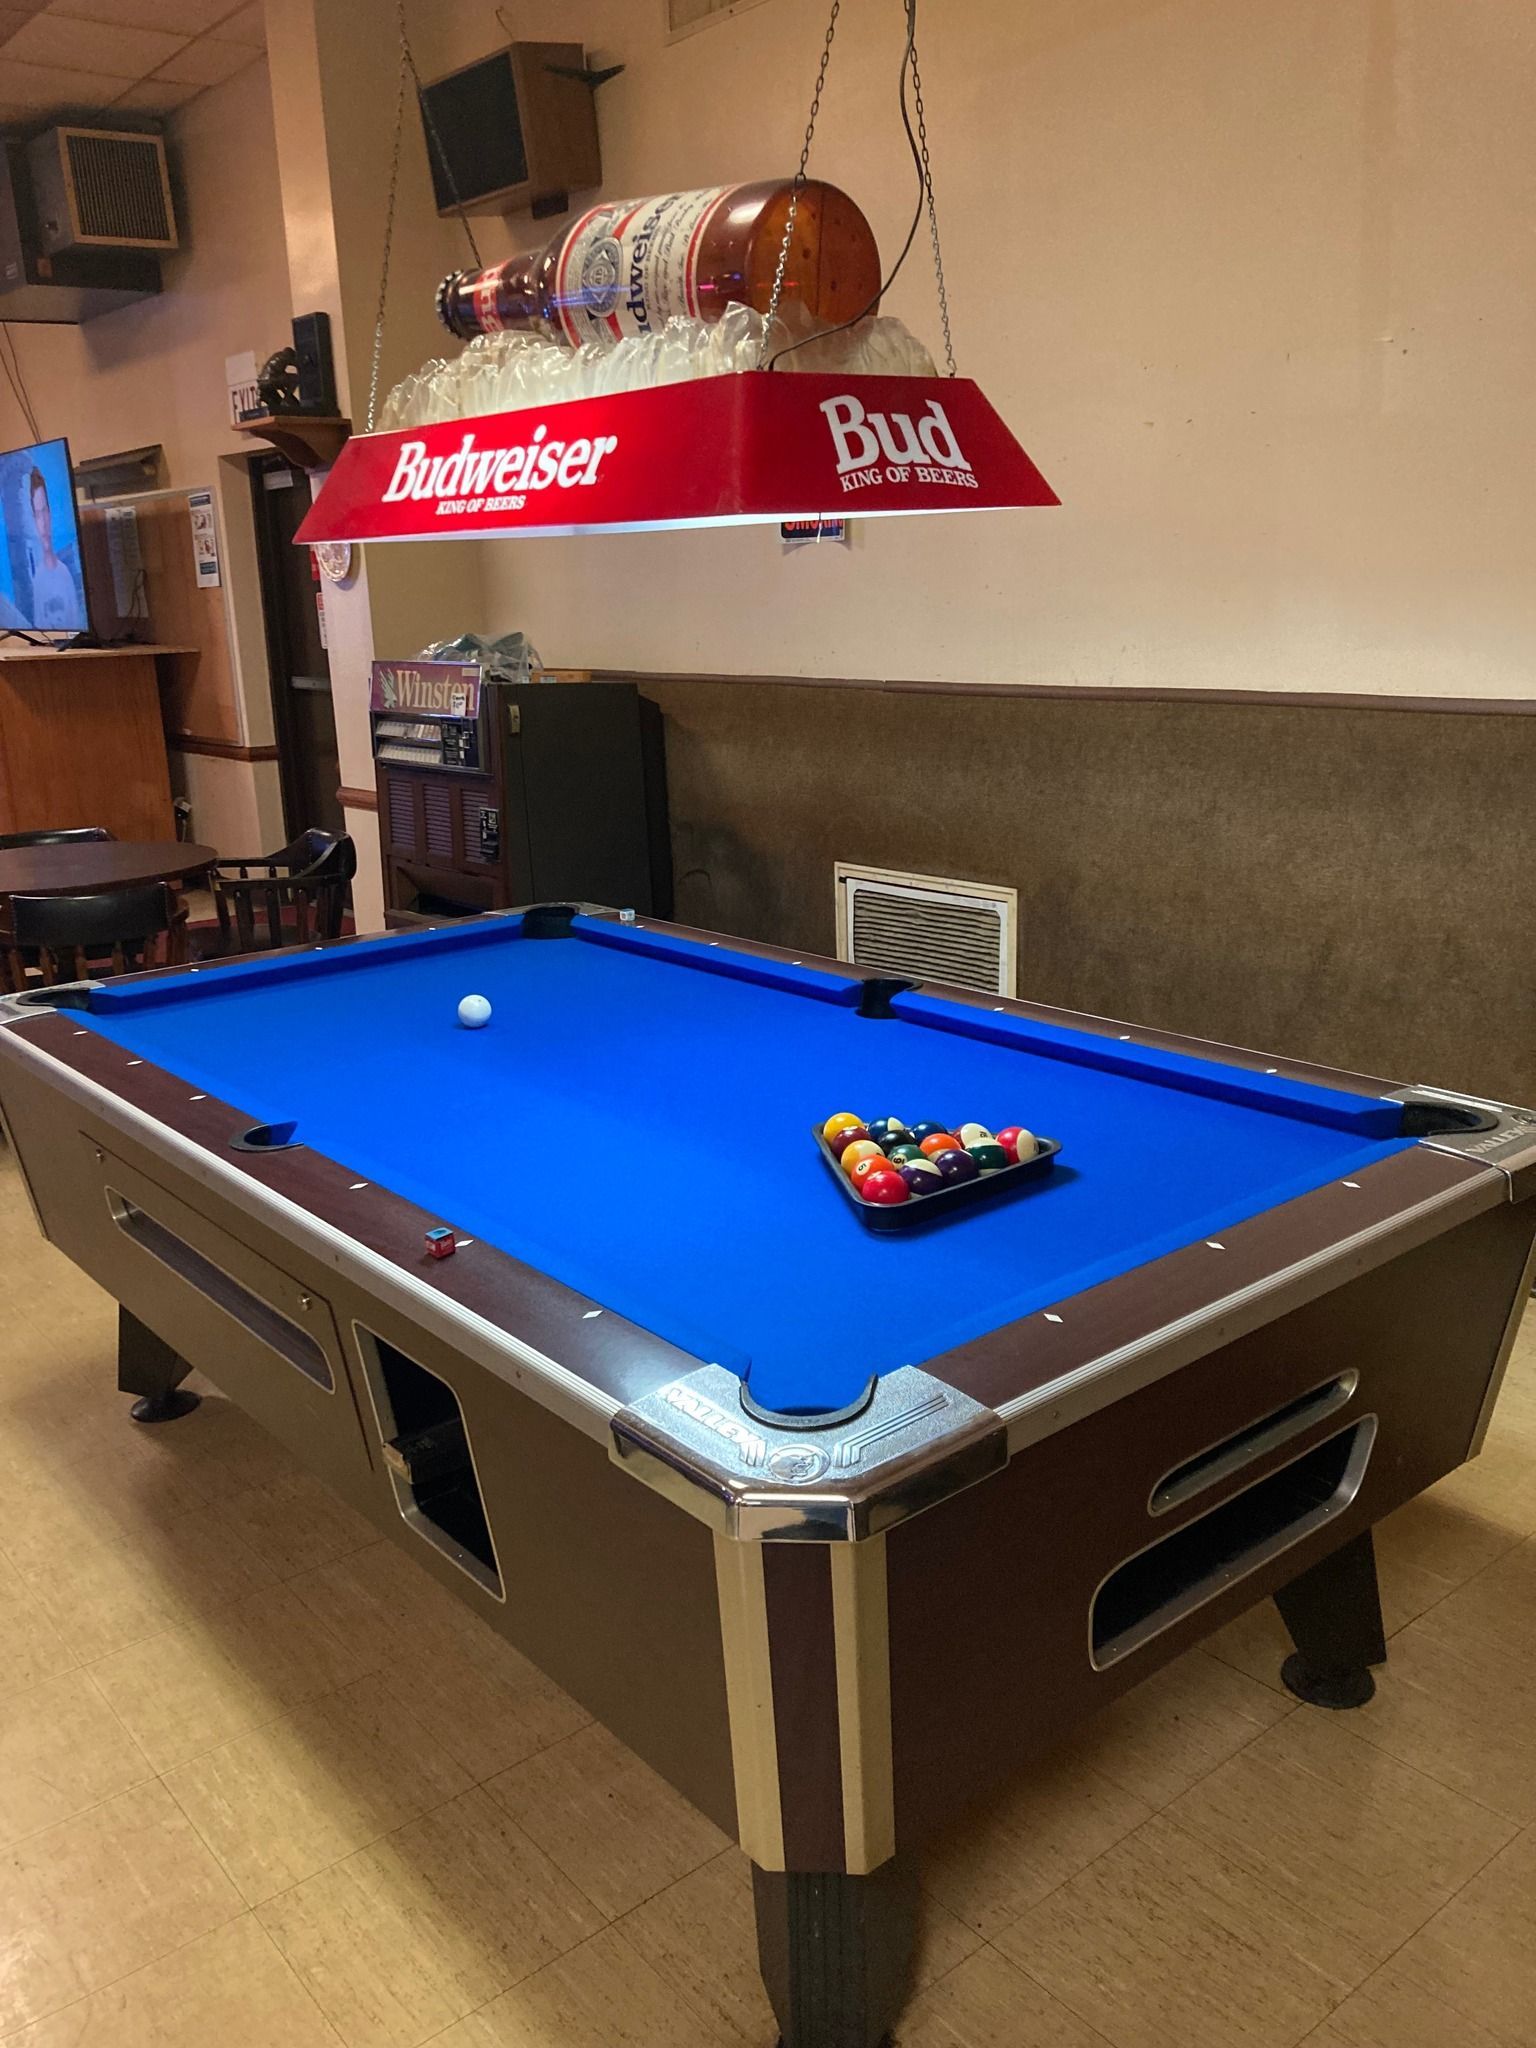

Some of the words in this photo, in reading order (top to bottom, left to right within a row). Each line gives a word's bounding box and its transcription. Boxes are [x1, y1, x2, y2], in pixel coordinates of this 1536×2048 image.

[819, 395, 973, 475] Bud
[381, 424, 618, 503] Budweiser
[840, 468, 883, 493] KING
[886, 466, 912, 483] OF
[914, 466, 979, 489] BEERS
[435, 499, 466, 515] KING
[465, 498, 485, 513] OF
[483, 495, 527, 512] BEERS
[396, 669, 475, 711] Winston
[1465, 1127, 1525, 1154] VALLEY
[665, 1387, 765, 1446] VALLEY
